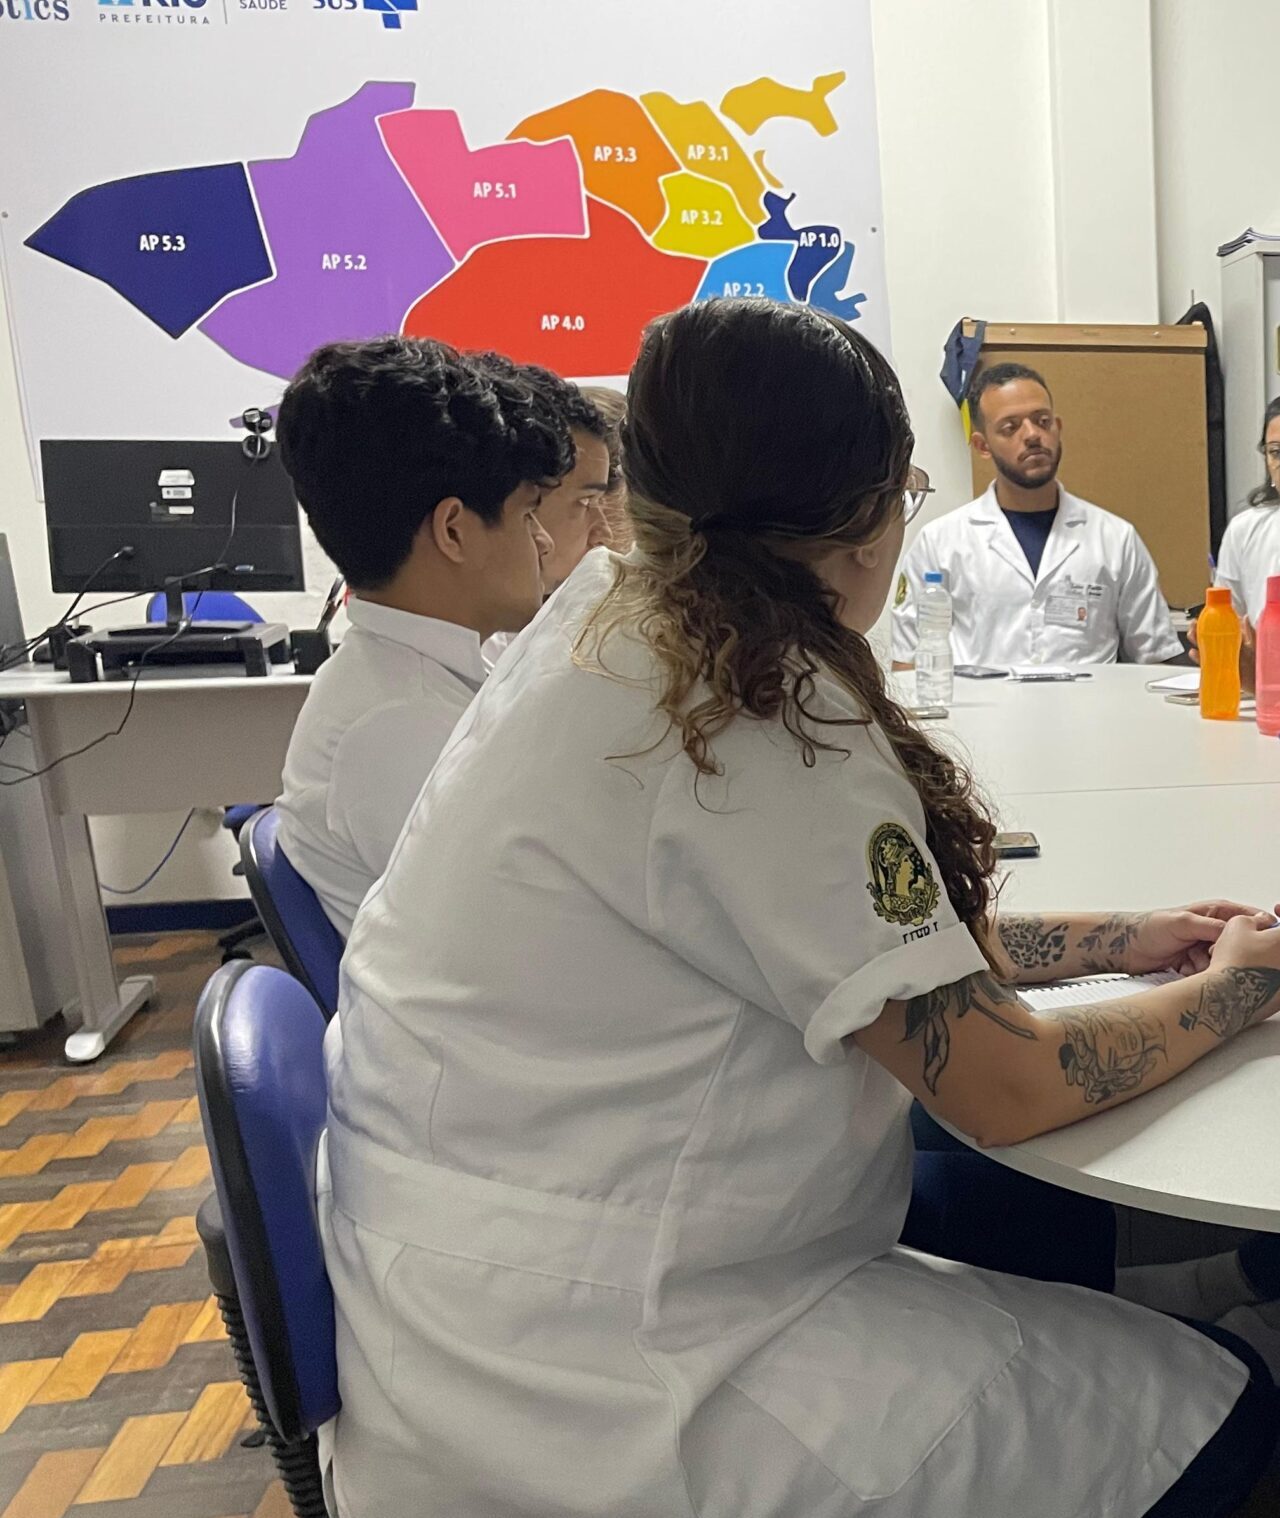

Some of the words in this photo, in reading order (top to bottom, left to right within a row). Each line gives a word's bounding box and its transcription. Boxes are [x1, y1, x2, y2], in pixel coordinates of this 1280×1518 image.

[0, 0, 70, 21] tics
[99, 13, 211, 25] PREFEITURA
[593, 145, 613, 162] AP
[615, 146, 637, 163] 3.3
[687, 144, 706, 160] AP
[708, 145, 729, 161] 3.1
[473, 181, 492, 198] AP
[495, 182, 517, 199] 5.1
[681, 209, 699, 225] AP
[702, 210, 722, 226] 3.2
[139, 234, 160, 251] AP
[162, 235, 186, 252] 5.3
[799, 231, 817, 247] AP
[818, 232, 840, 248] 1.0
[322, 253, 341, 270] AP
[344, 254, 367, 270] 5.2
[723, 282, 741, 298] AP
[744, 283, 765, 298] 2.2
[541, 314, 560, 330] AP
[562, 315, 585, 331] 4.0
